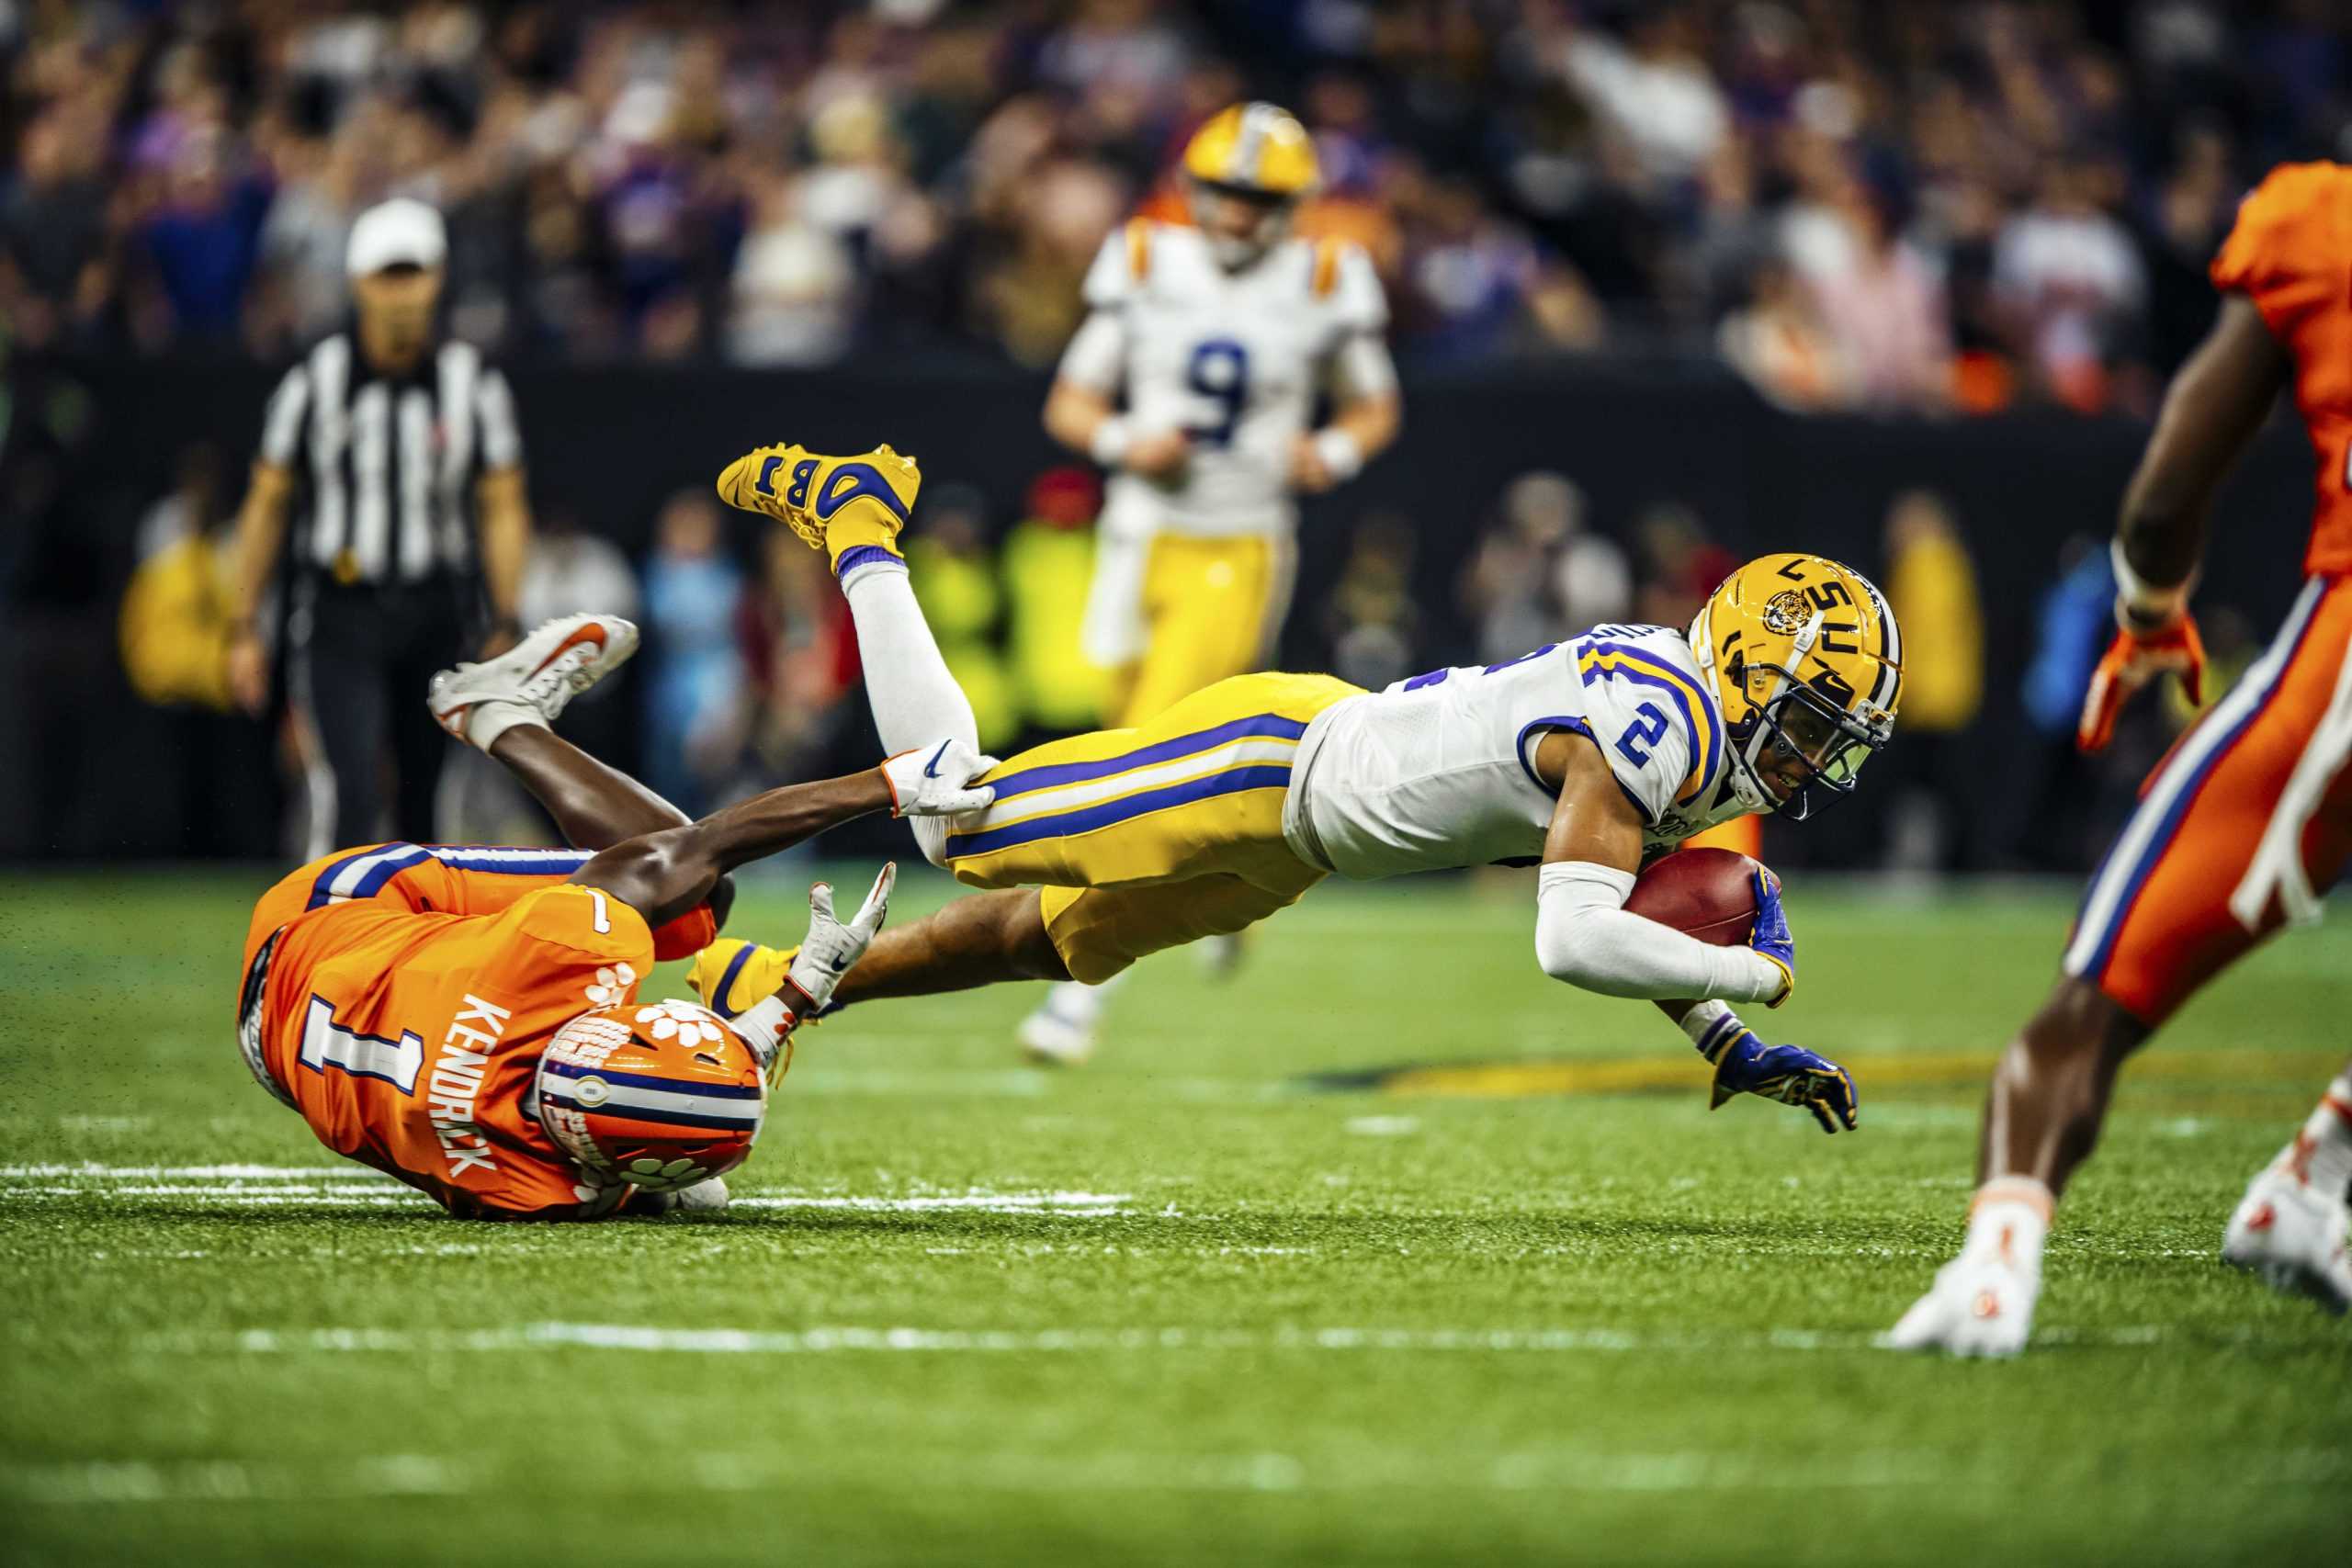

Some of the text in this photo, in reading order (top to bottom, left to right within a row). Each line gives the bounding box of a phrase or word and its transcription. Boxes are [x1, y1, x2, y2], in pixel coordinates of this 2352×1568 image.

[1188, 338, 1250, 448] 9
[1777, 558, 1859, 655] LSU
[1615, 701, 1670, 771] 2
[300, 992, 424, 1097] 1
[427, 993, 512, 1179] KENDRICK
